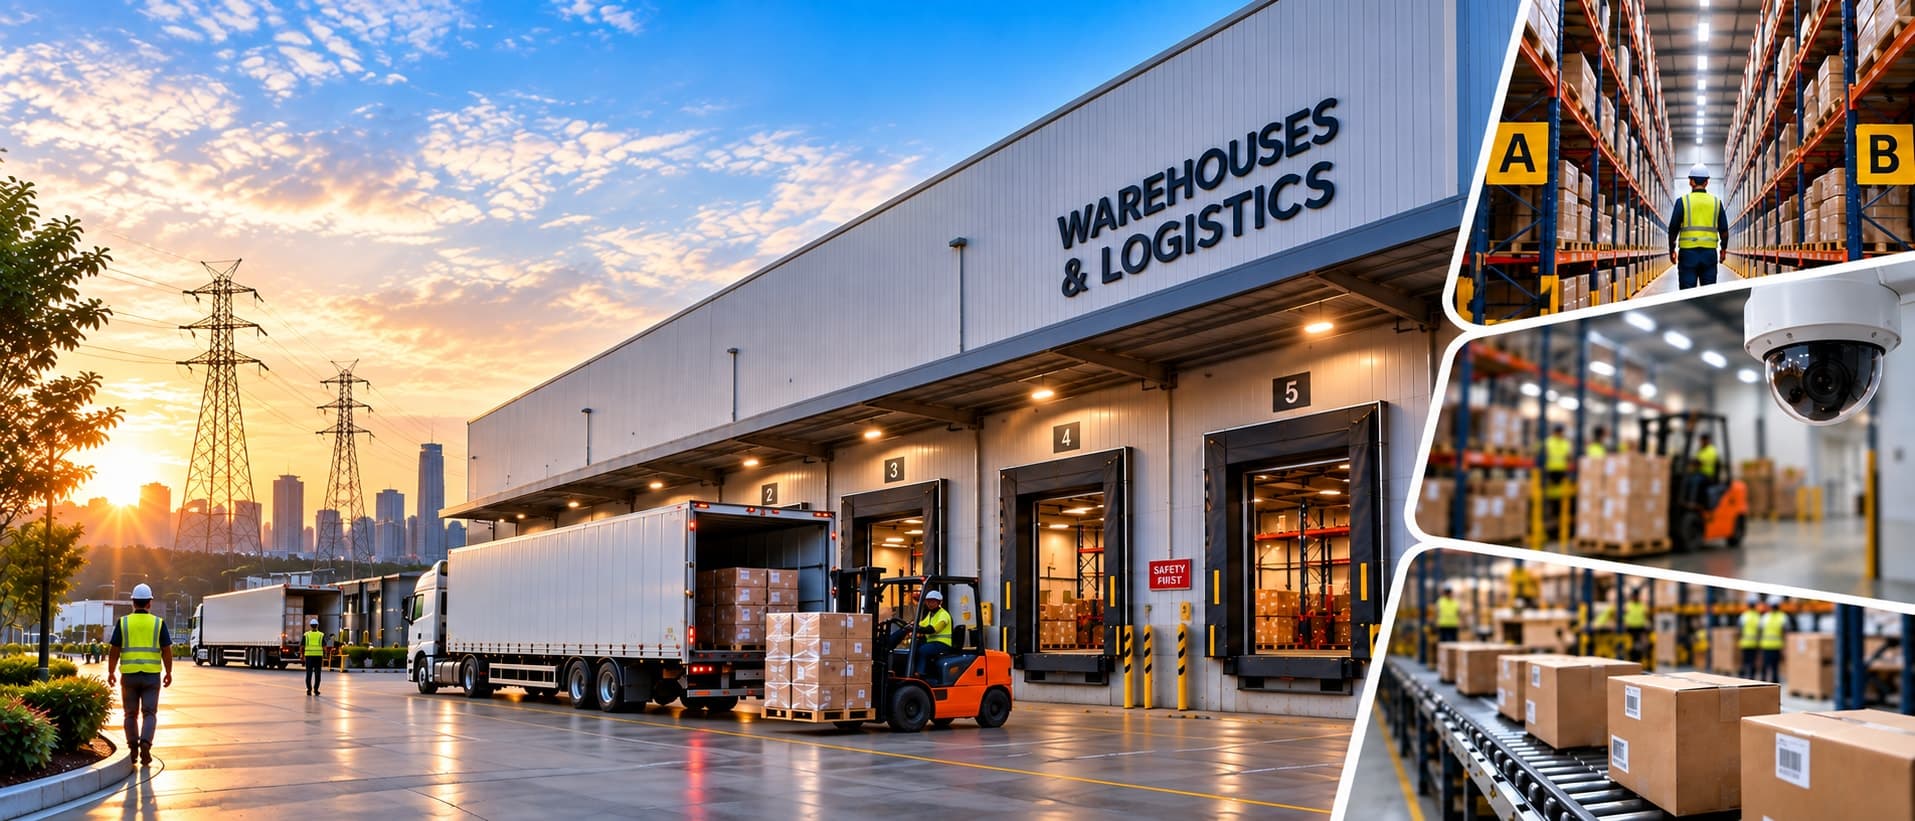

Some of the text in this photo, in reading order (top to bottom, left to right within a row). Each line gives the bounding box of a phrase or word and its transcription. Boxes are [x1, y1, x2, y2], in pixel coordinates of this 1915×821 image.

[1499, 133, 1536, 172] A
[1870, 134, 1900, 174] B
[1057, 97, 1339, 250] WAREHOUSES
[1061, 161, 1335, 298] & LOGISTICS
[1285, 380, 1298, 404] 5
[1061, 428, 1071, 447] 4
[890, 462, 898, 478] 3
[766, 487, 773, 502] 2
[1153, 565, 1185, 574] SAFETY
